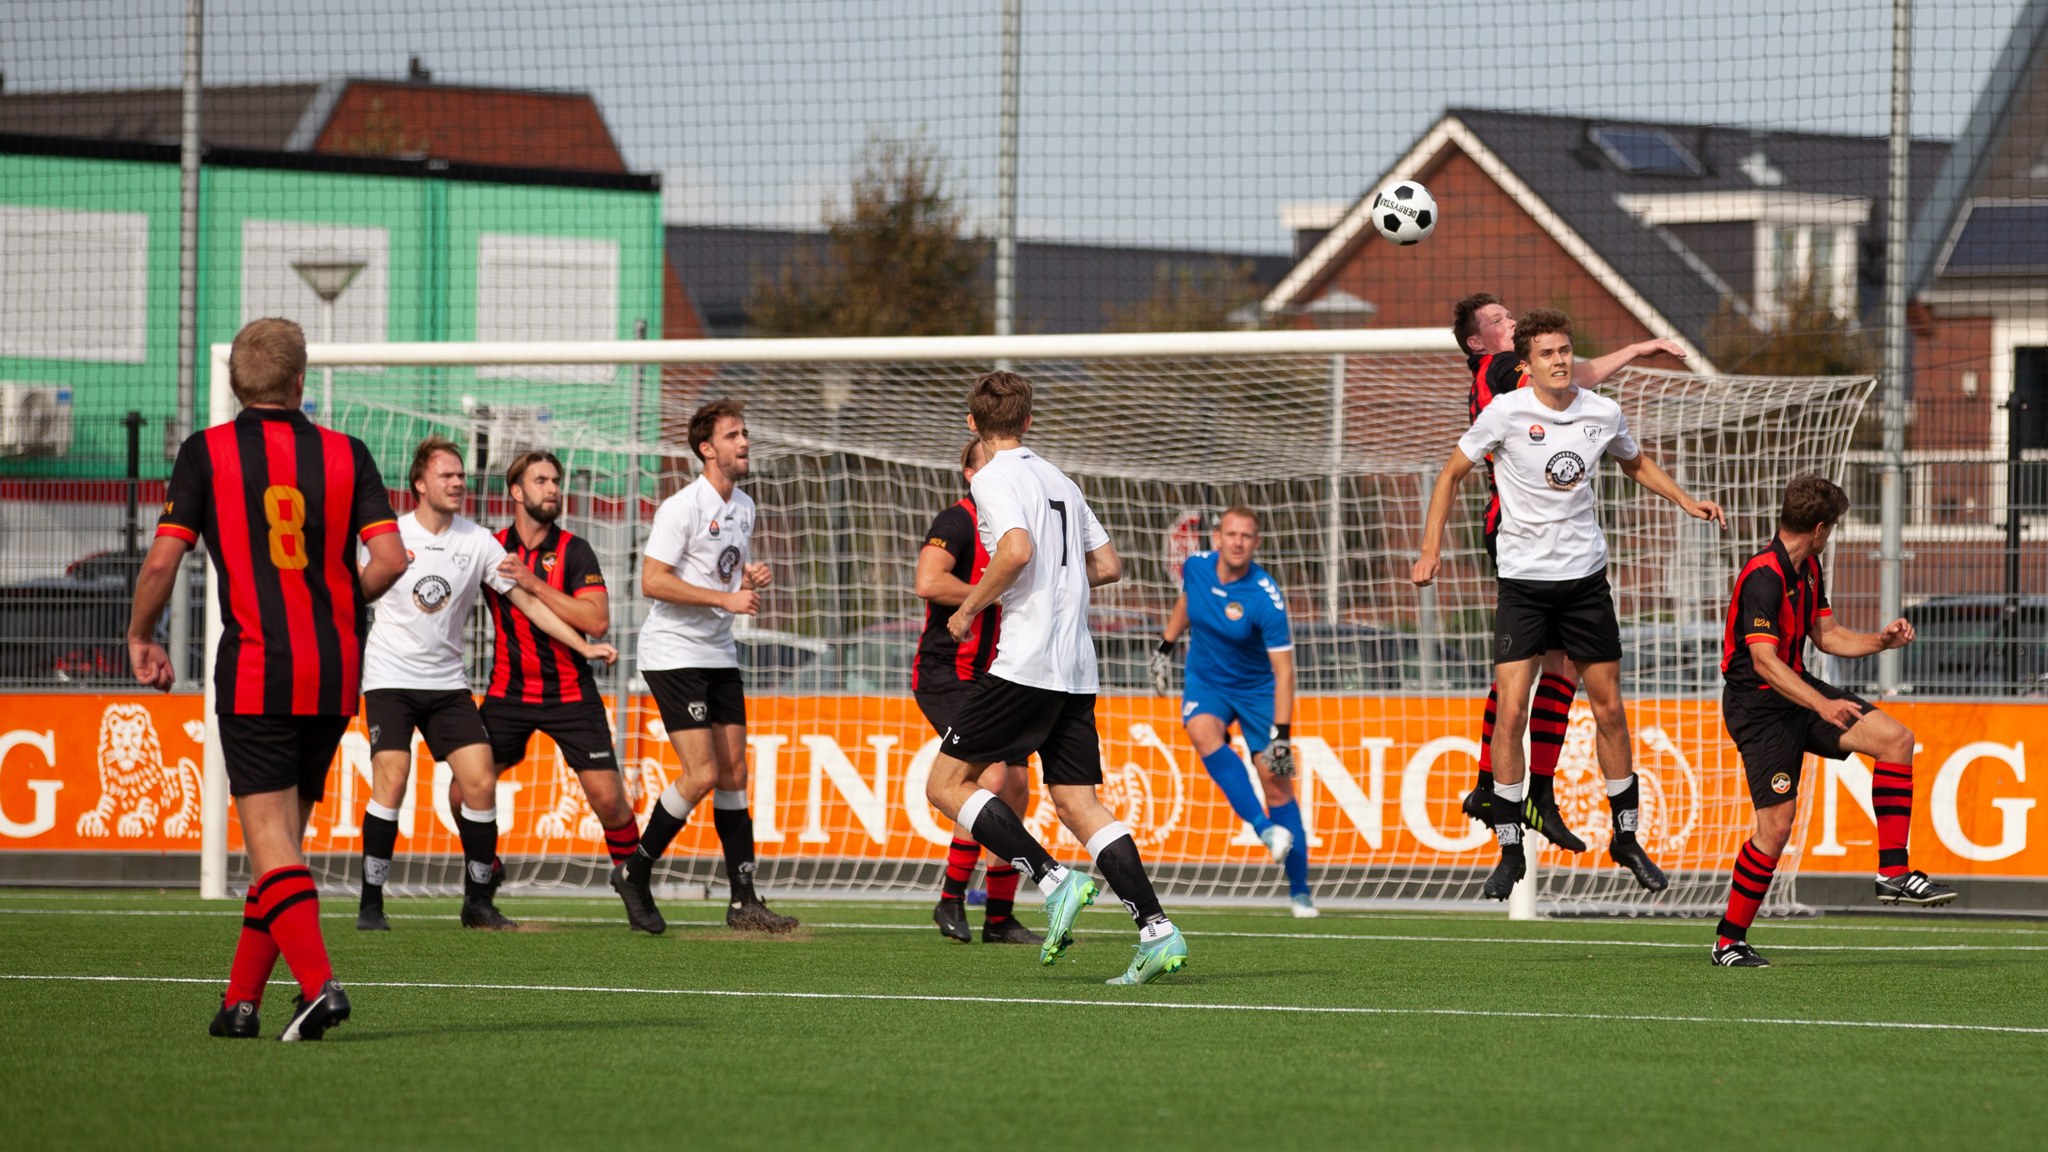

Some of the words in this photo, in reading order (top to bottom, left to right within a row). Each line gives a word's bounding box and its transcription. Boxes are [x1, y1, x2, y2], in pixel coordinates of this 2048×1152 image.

[263, 485, 309, 570] 8
[1048, 498, 1068, 567] 7
[304, 731, 523, 839] NG
[1783, 741, 2037, 862] NG
